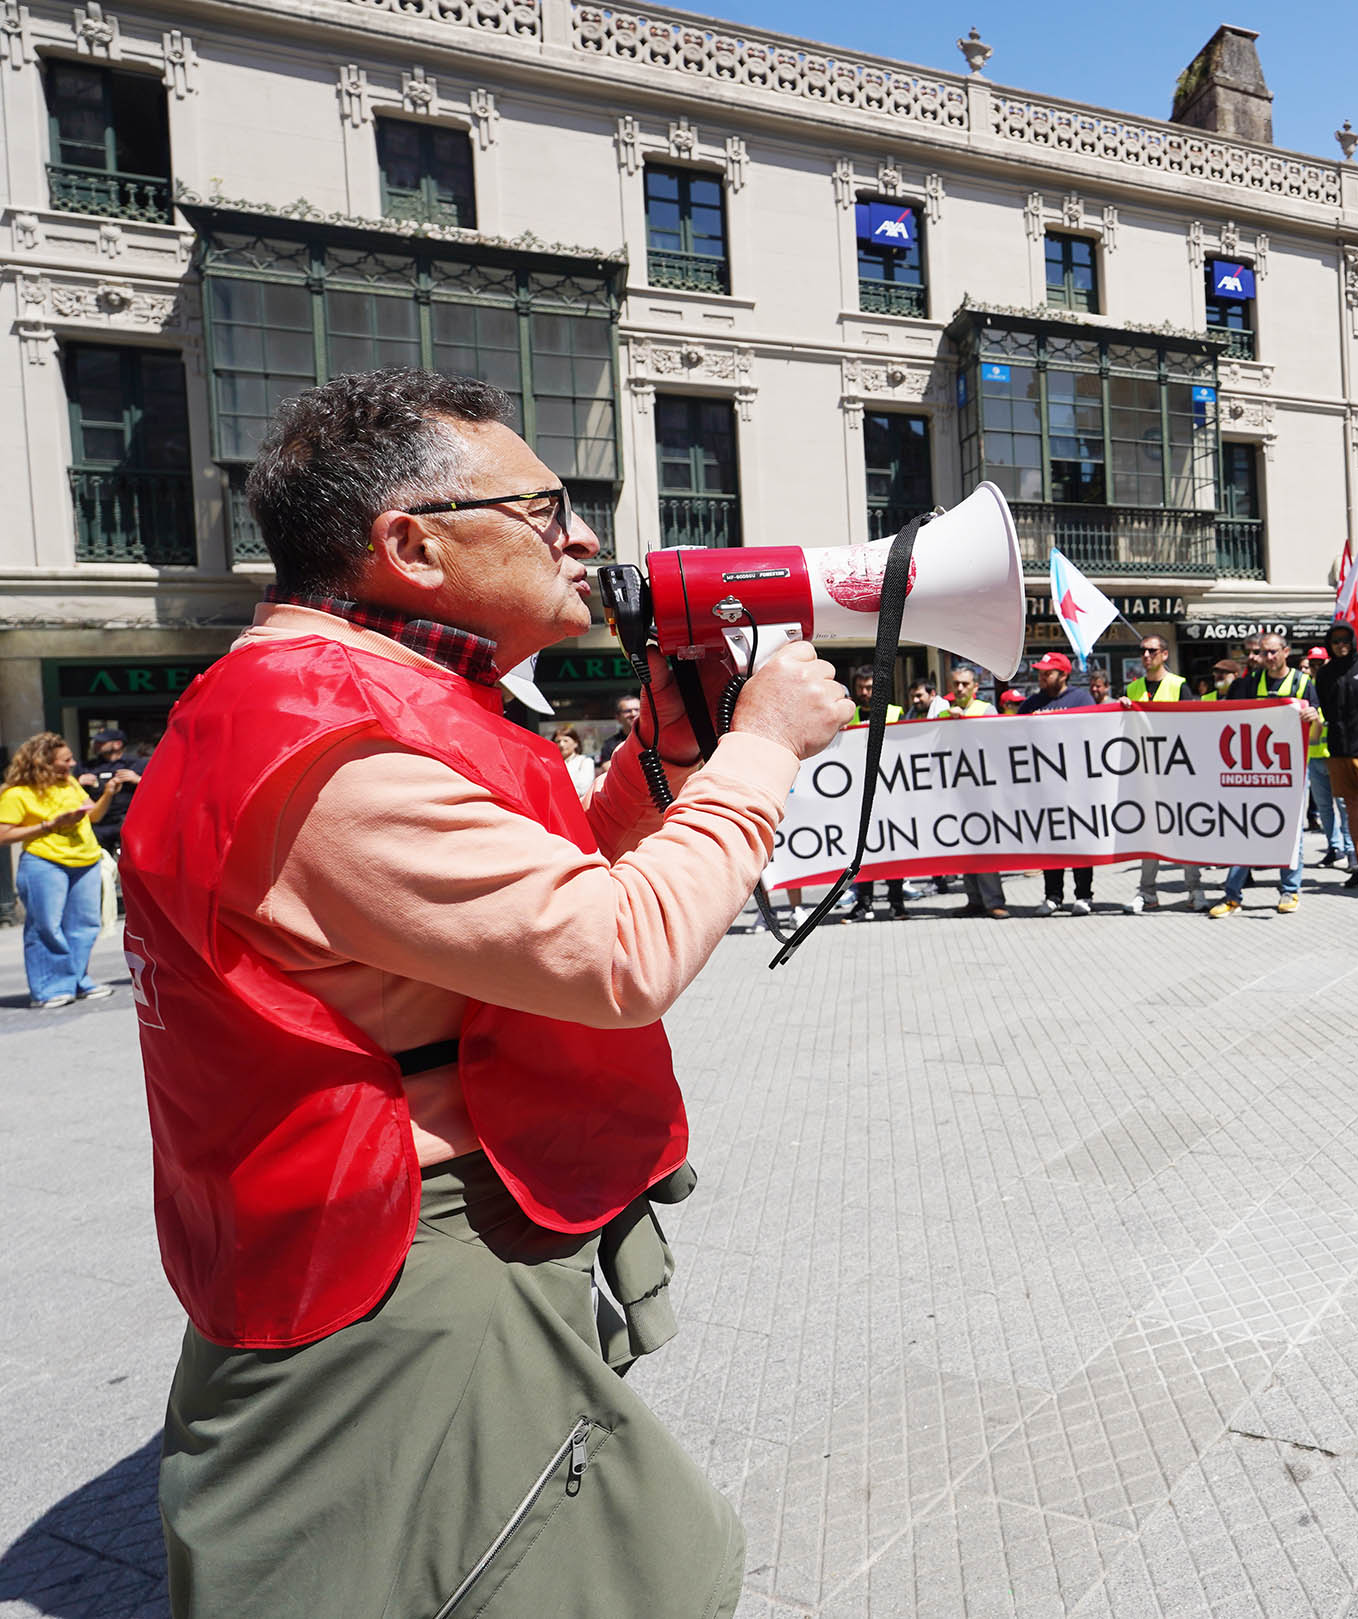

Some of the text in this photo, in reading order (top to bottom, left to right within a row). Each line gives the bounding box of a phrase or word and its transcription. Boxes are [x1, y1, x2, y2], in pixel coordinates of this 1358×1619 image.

[875, 220, 909, 239] AXA
[1217, 275, 1243, 292] AXA
[1219, 723, 1292, 770] CIG
[812, 734, 1196, 798] O METAL EN LOITA
[1221, 774, 1290, 786] INDUSTRIA
[770, 800, 1286, 863] POR UN CONVENIO DIGNO
